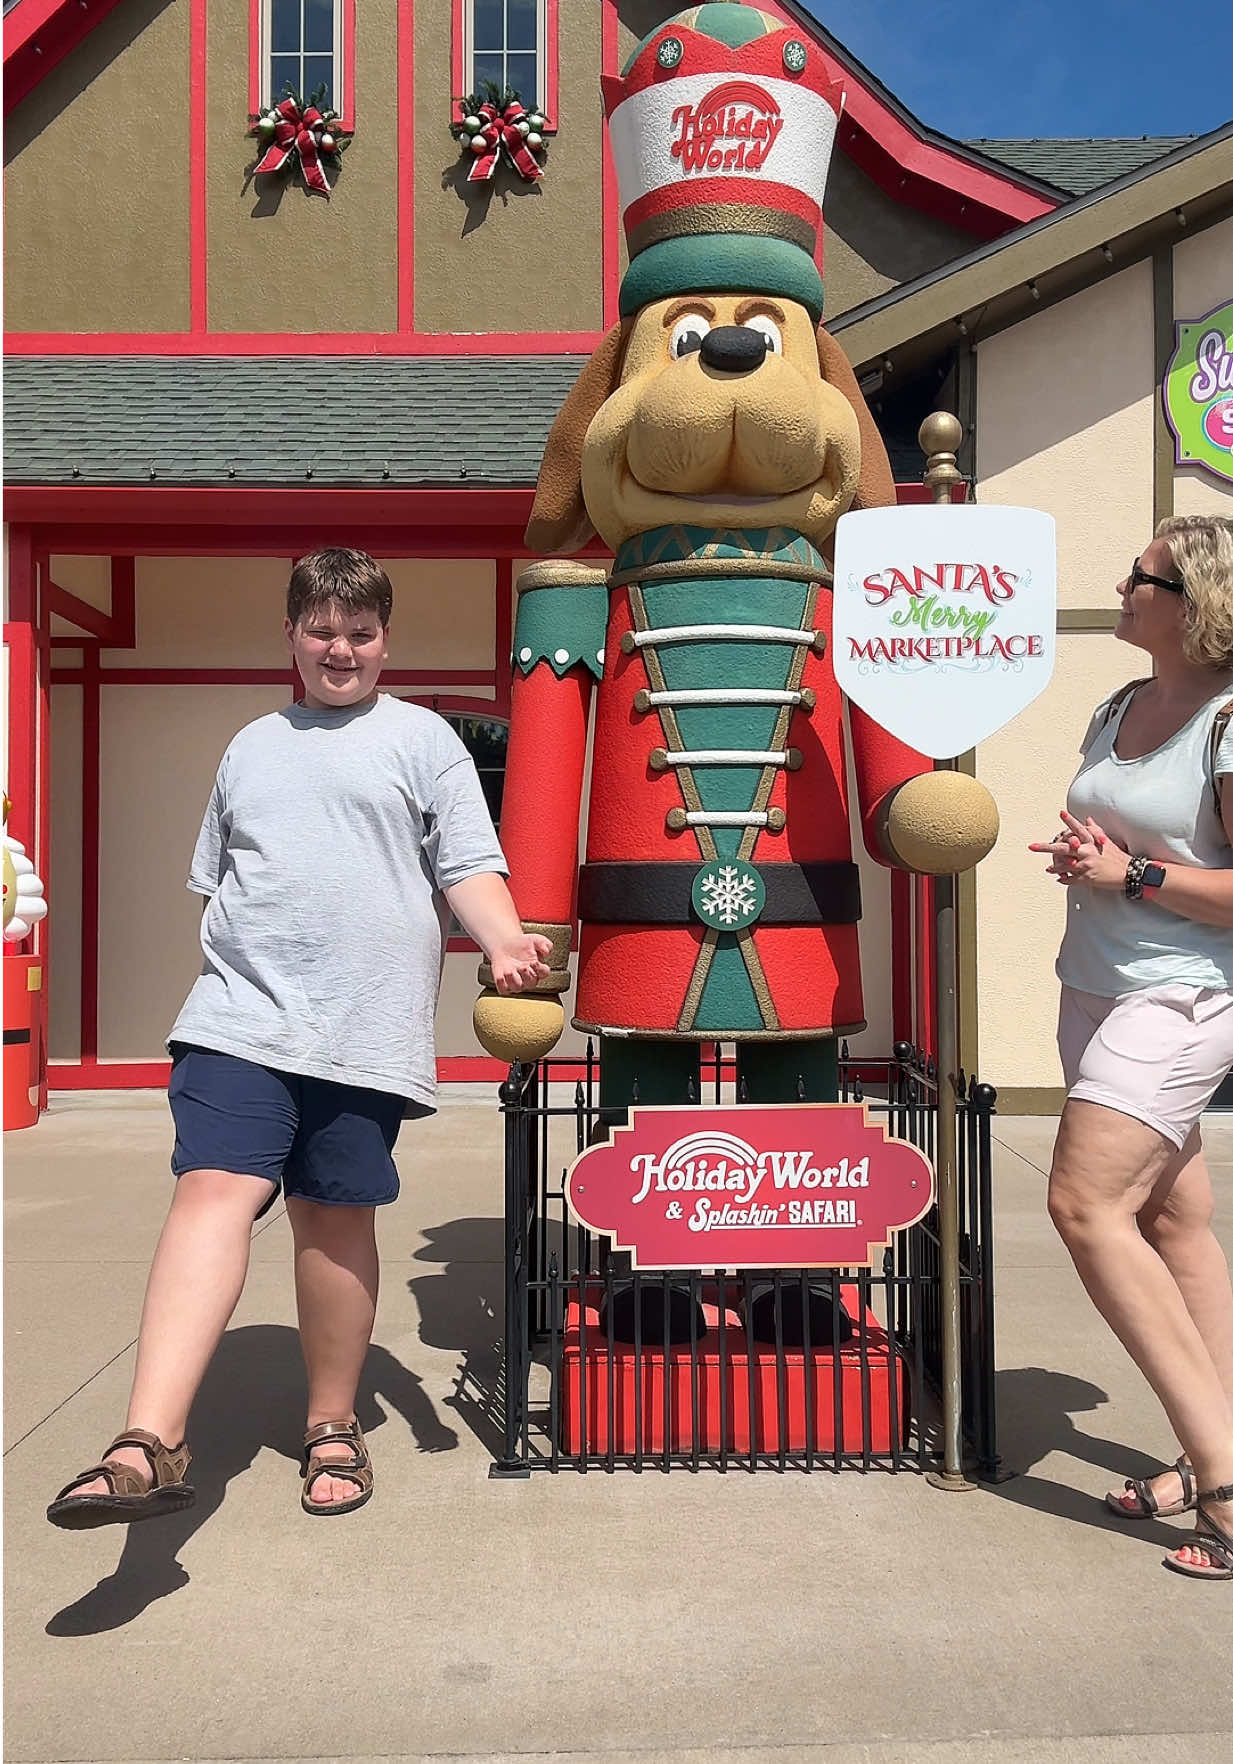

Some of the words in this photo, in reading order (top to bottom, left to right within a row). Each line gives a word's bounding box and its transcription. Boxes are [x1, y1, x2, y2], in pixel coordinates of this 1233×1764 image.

[671, 104, 784, 151] Holiday
[671, 136, 764, 171] World
[863, 563, 1016, 606] SANTA'S
[891, 595, 997, 639] Merry
[848, 635, 1044, 663] MARKETPLACE
[630, 1153, 766, 1204] Holiday
[757, 1151, 870, 1189] World
[665, 1201, 684, 1220] &
[688, 1197, 786, 1232] Splashin'
[788, 1200, 857, 1224] SAFARI
